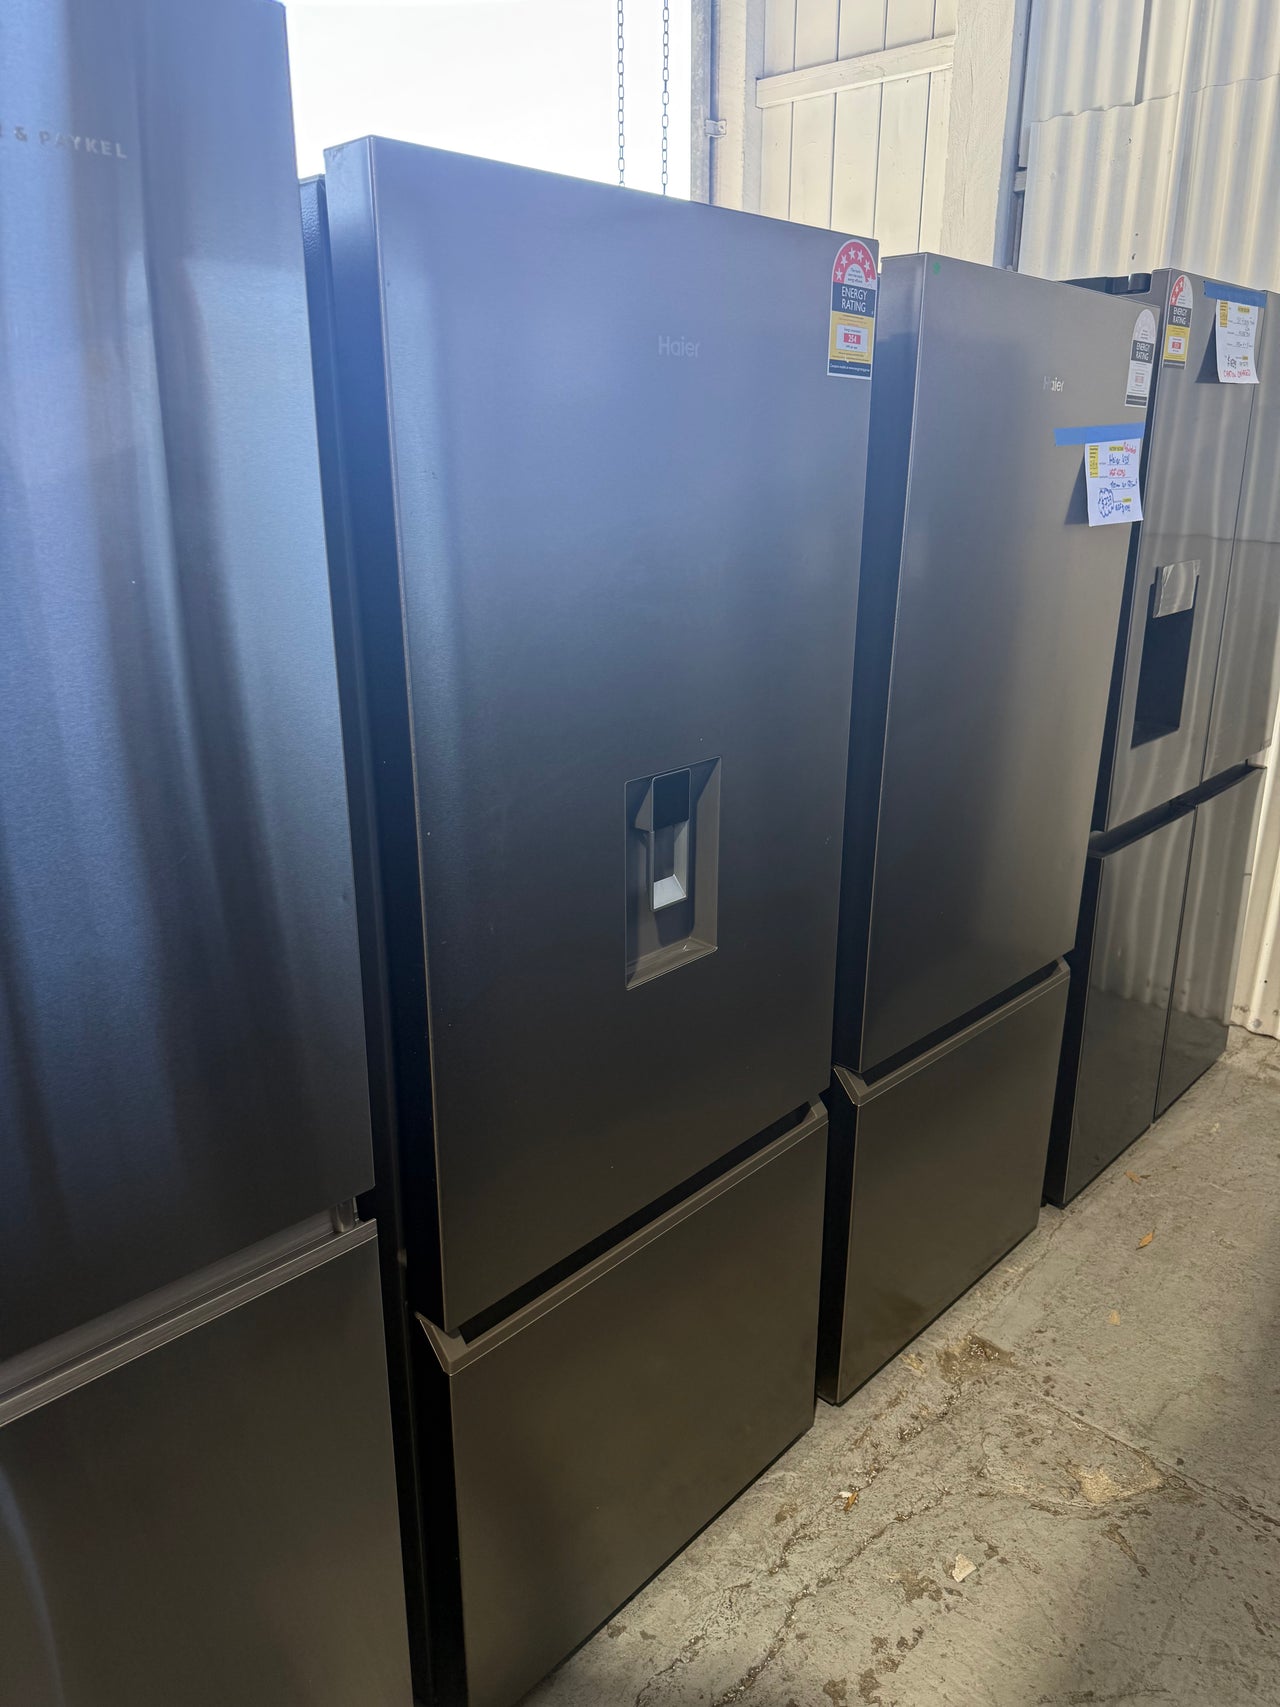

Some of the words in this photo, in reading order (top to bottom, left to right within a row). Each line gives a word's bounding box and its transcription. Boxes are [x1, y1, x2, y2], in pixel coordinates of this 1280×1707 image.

[14, 126, 27, 141] &
[39, 130, 128, 159] PAYKEL
[841, 286, 868, 301] ENERGY
[841, 299, 866, 313] RATING
[658, 335, 701, 358] Haier
